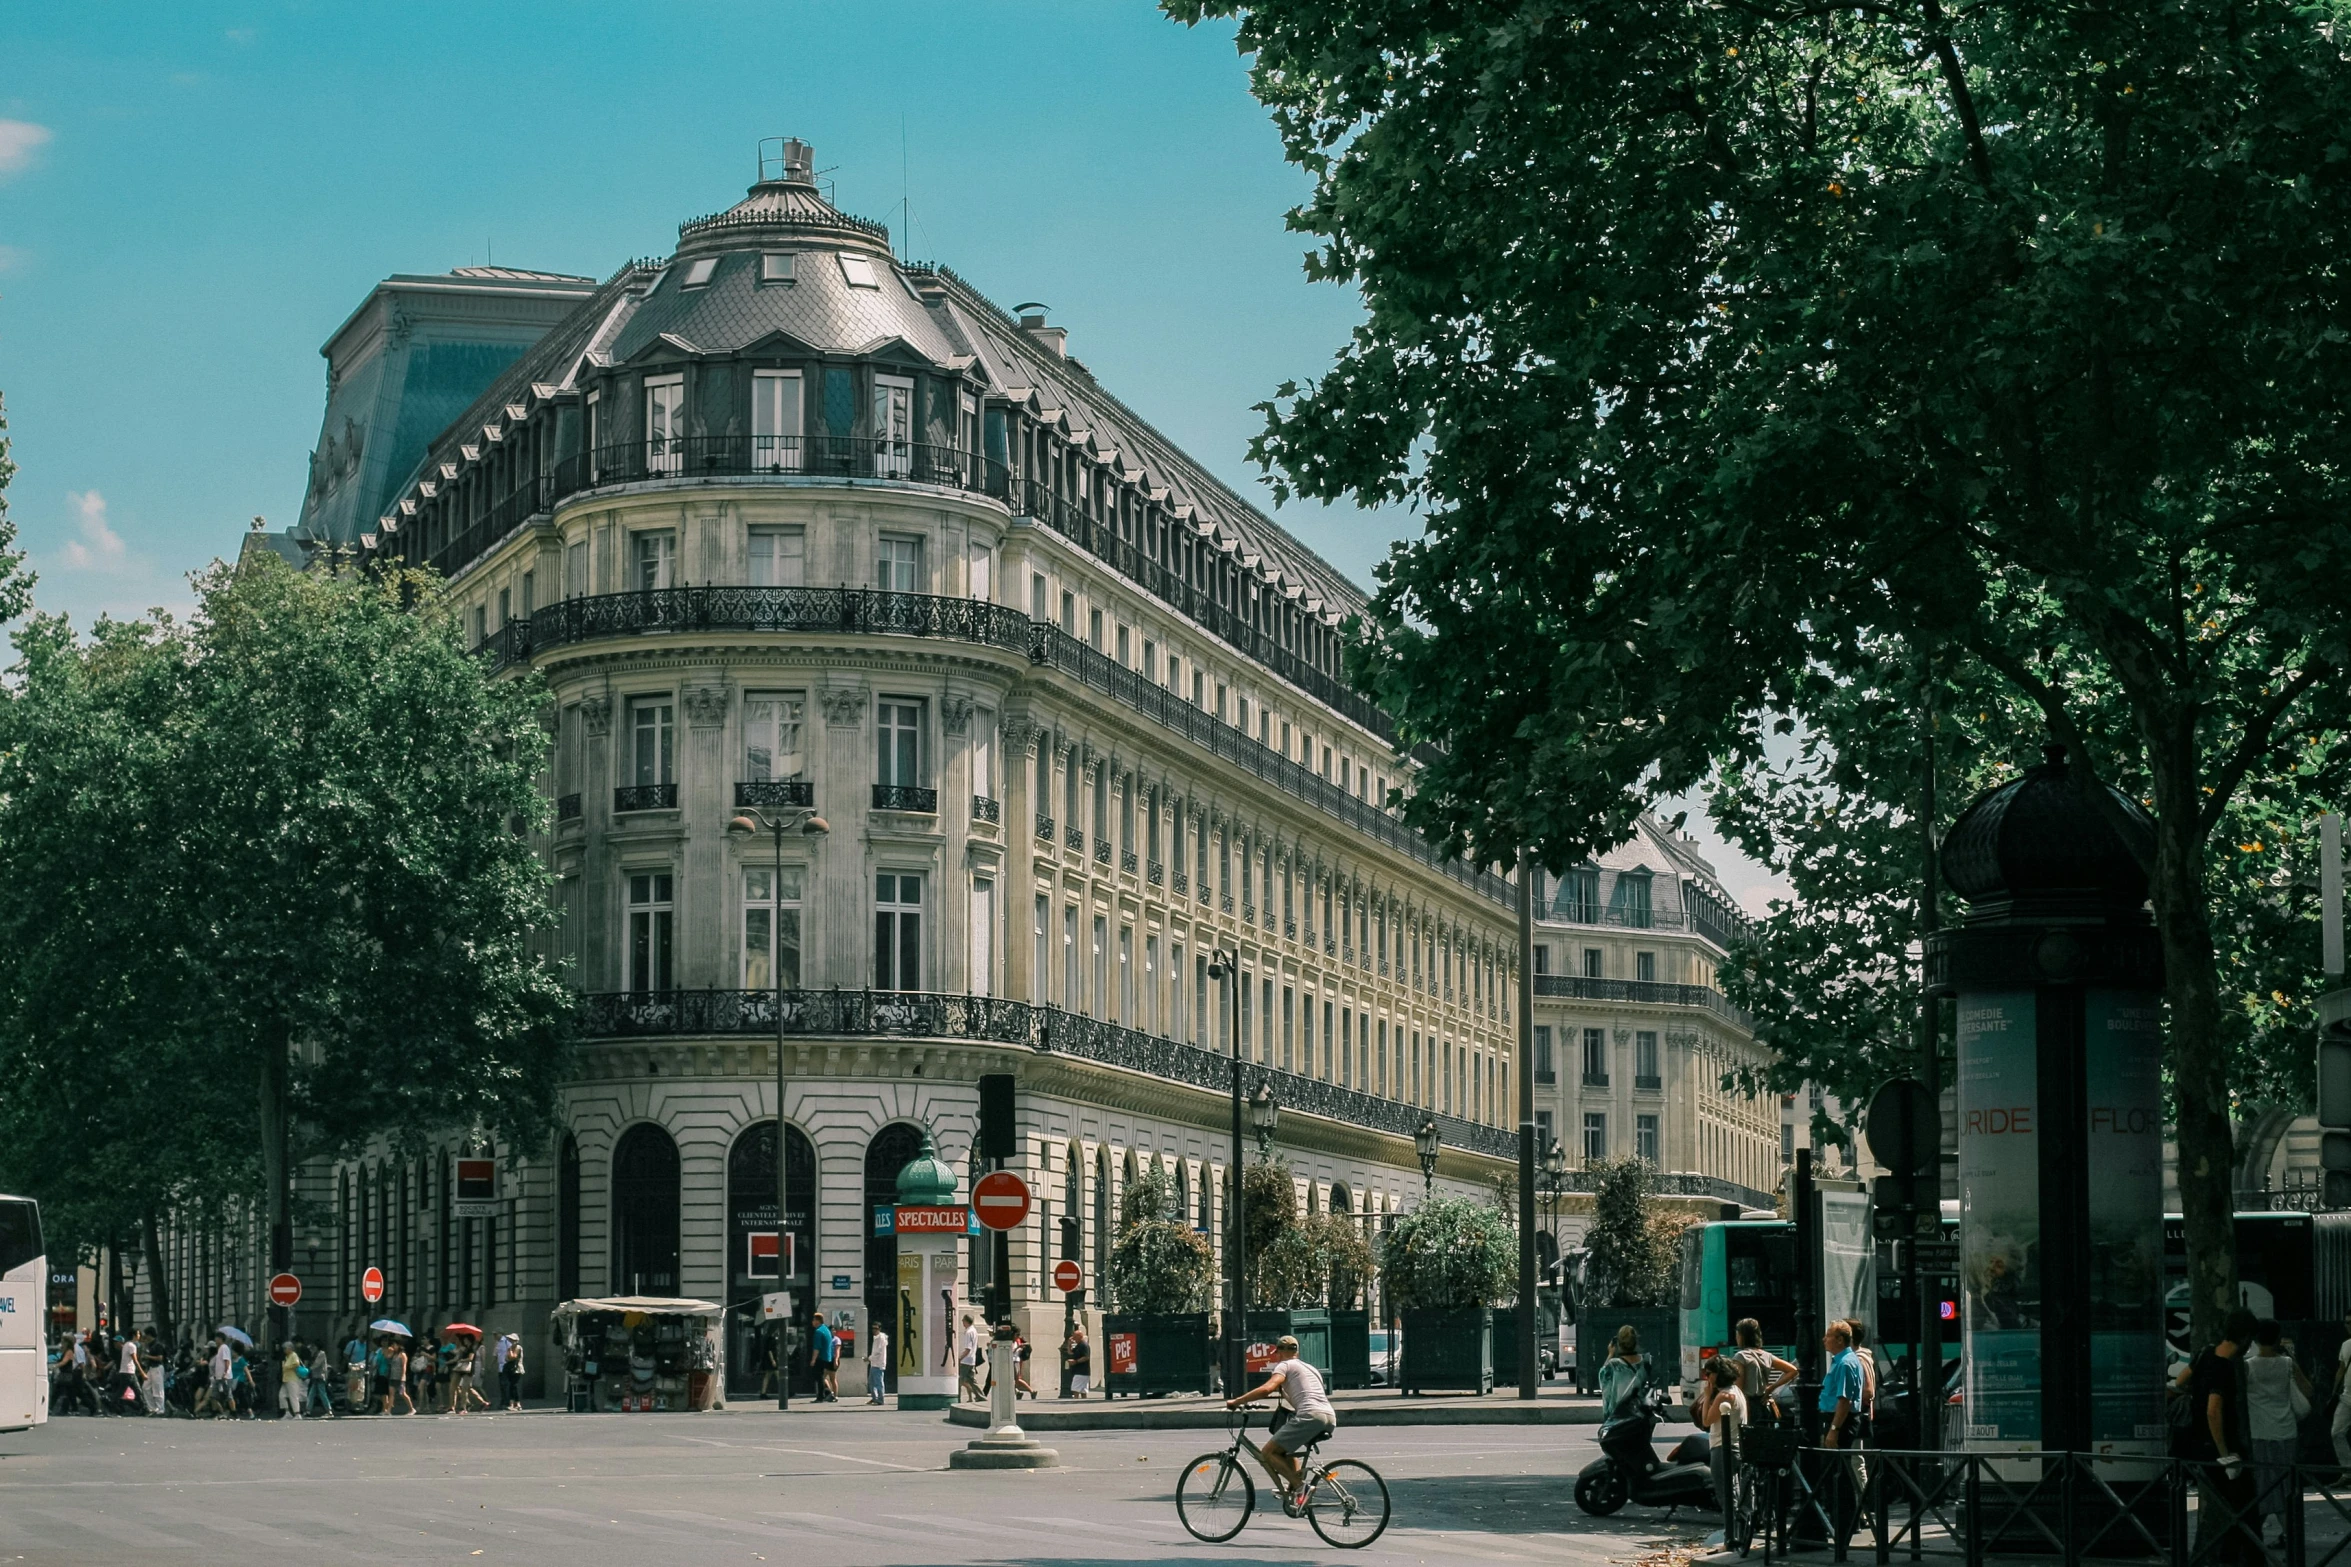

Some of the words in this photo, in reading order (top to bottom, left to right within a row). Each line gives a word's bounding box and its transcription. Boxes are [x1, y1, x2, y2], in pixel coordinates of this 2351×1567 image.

[898, 1212, 965, 1227] SPECTACLES
[52, 1274, 75, 1283] ORA
[1115, 1340, 1132, 1360] PCF
